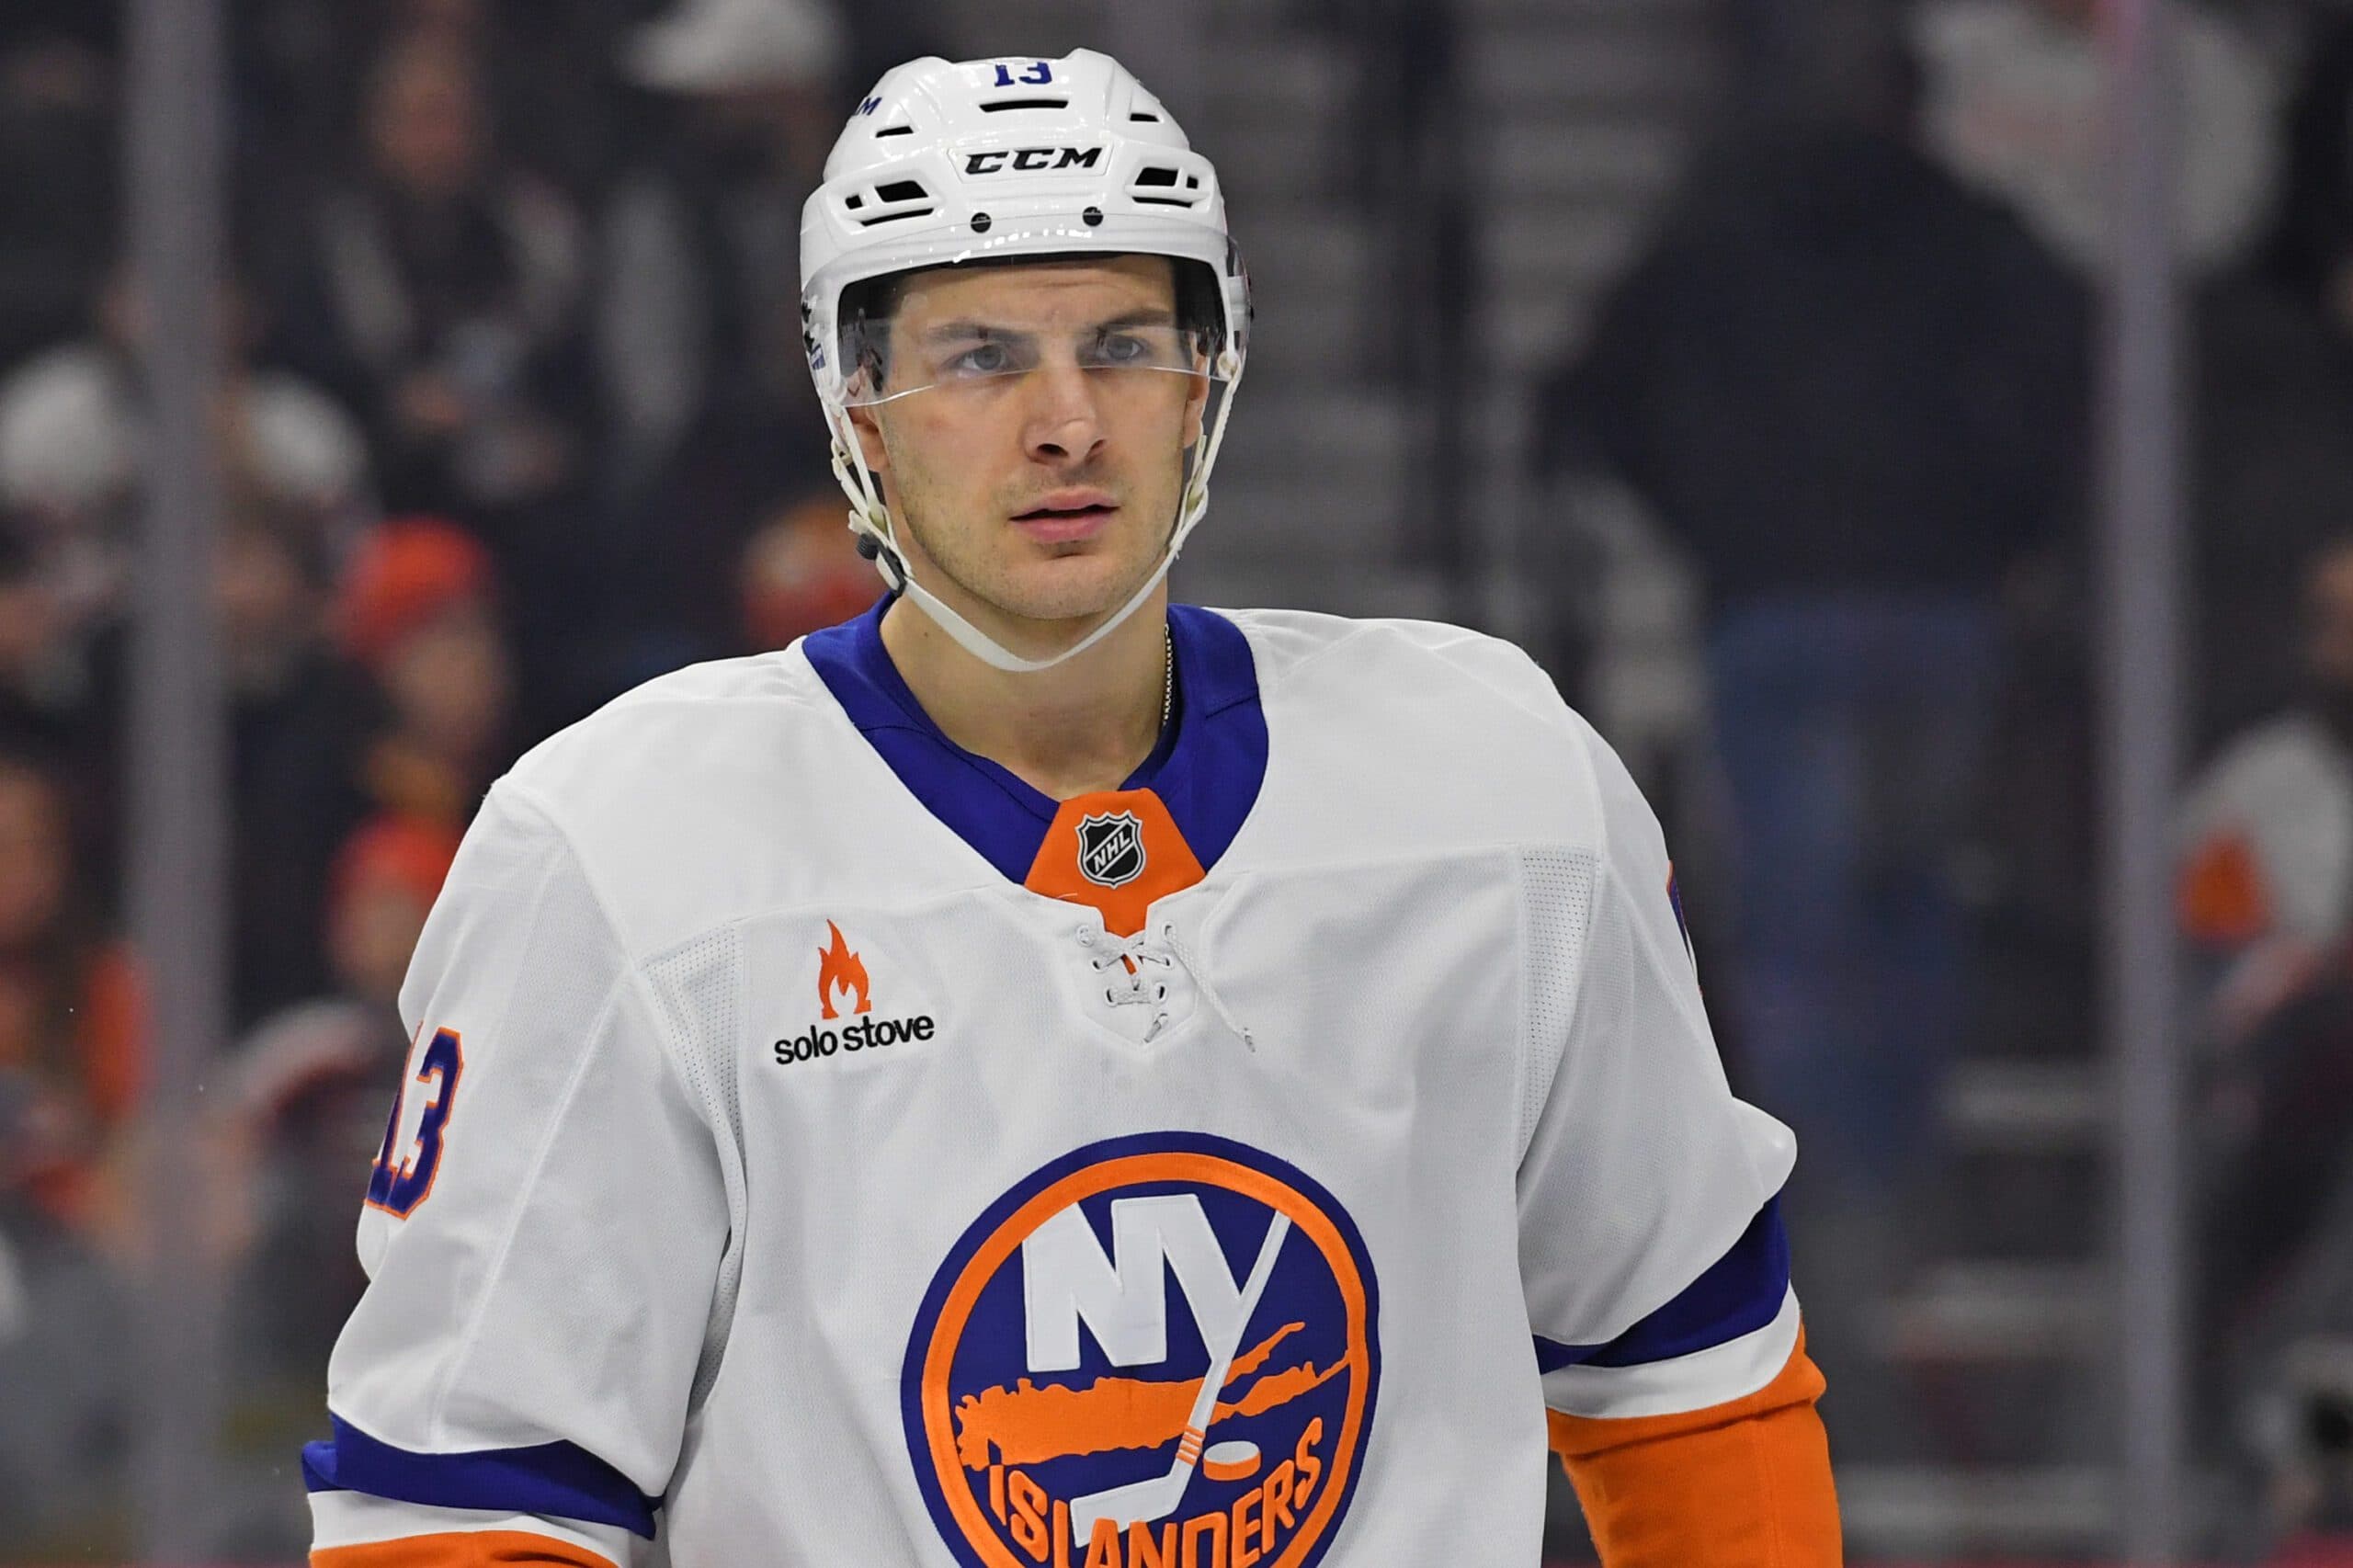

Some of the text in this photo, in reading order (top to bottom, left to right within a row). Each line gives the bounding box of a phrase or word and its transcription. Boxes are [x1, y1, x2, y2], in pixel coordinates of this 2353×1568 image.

[995, 62, 1052, 86] 13
[965, 147, 1102, 175] CCM
[1093, 830, 1131, 873] NHL
[774, 1016, 935, 1064] solo stove
[1021, 1194, 1291, 1388] NY
